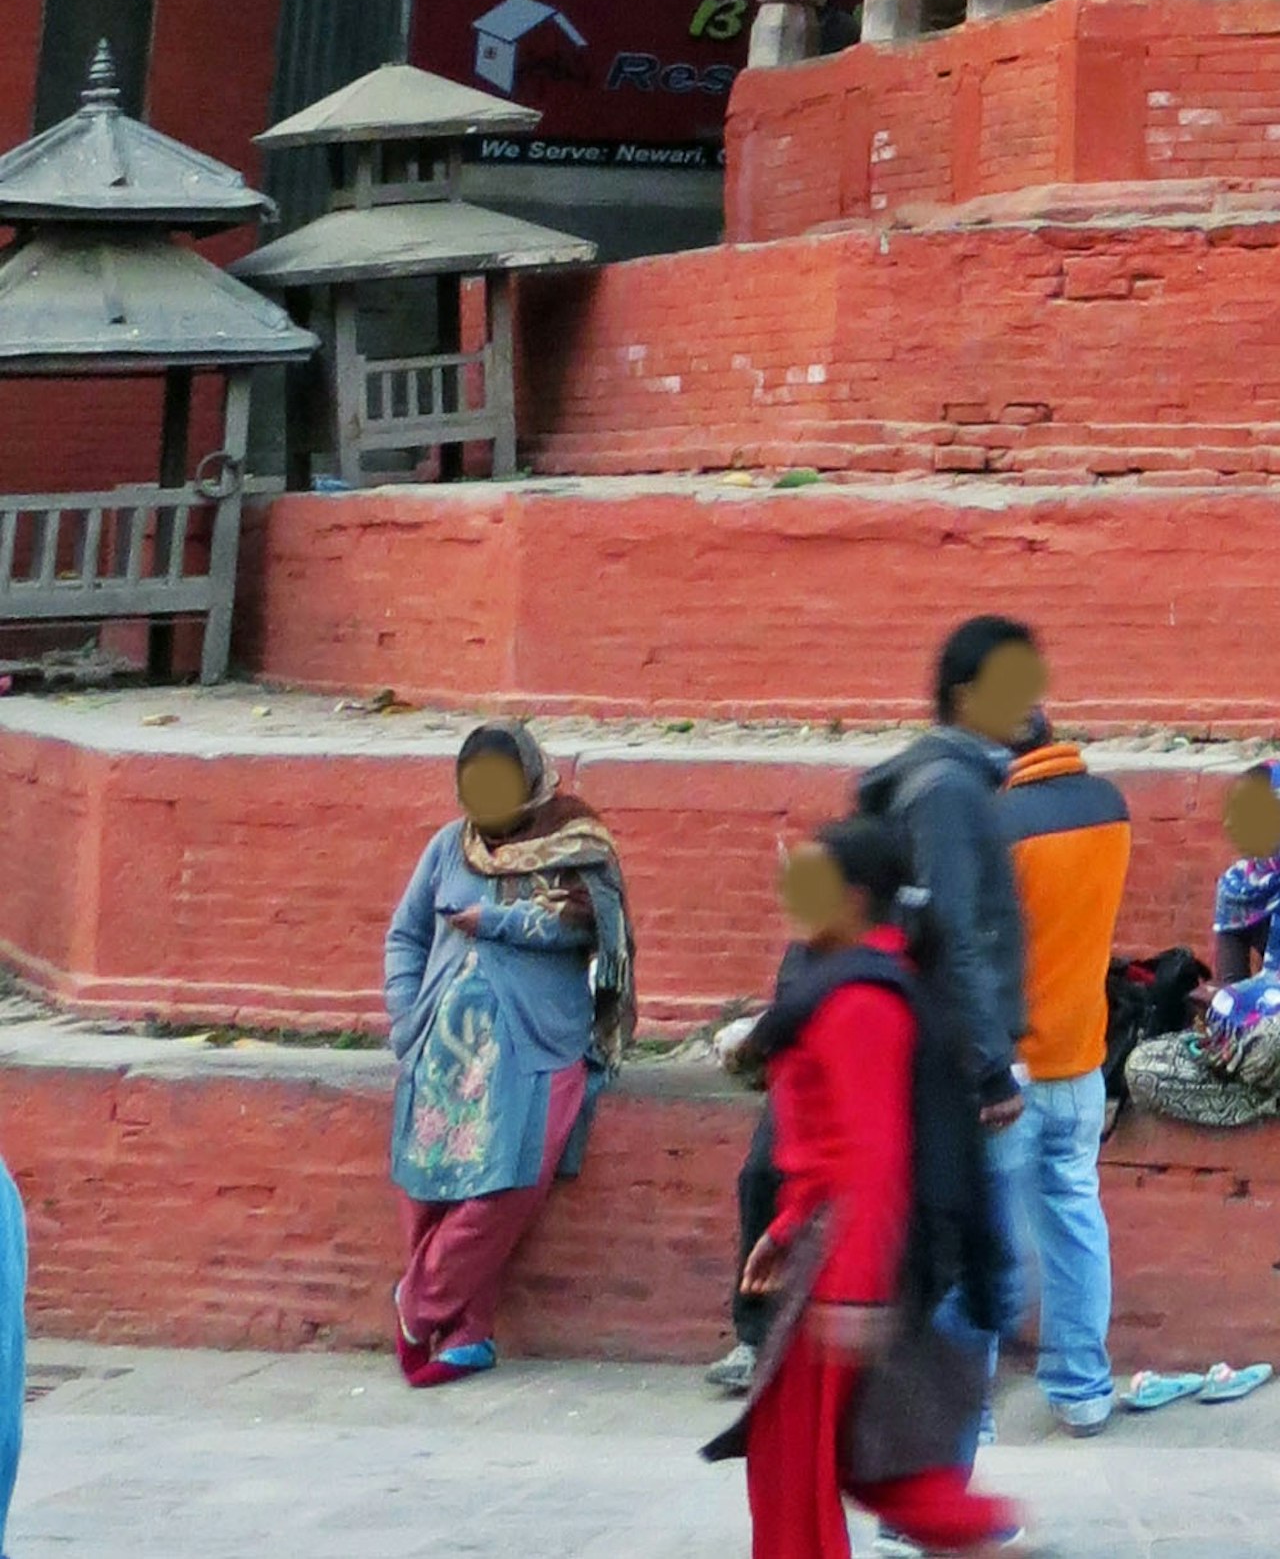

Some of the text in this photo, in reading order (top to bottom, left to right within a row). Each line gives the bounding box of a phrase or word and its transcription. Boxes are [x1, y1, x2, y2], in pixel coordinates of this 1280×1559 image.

[607, 50, 736, 95] Res
[481, 138, 520, 159] We
[528, 140, 609, 161] Serve:
[615, 143, 707, 166] Newari,
